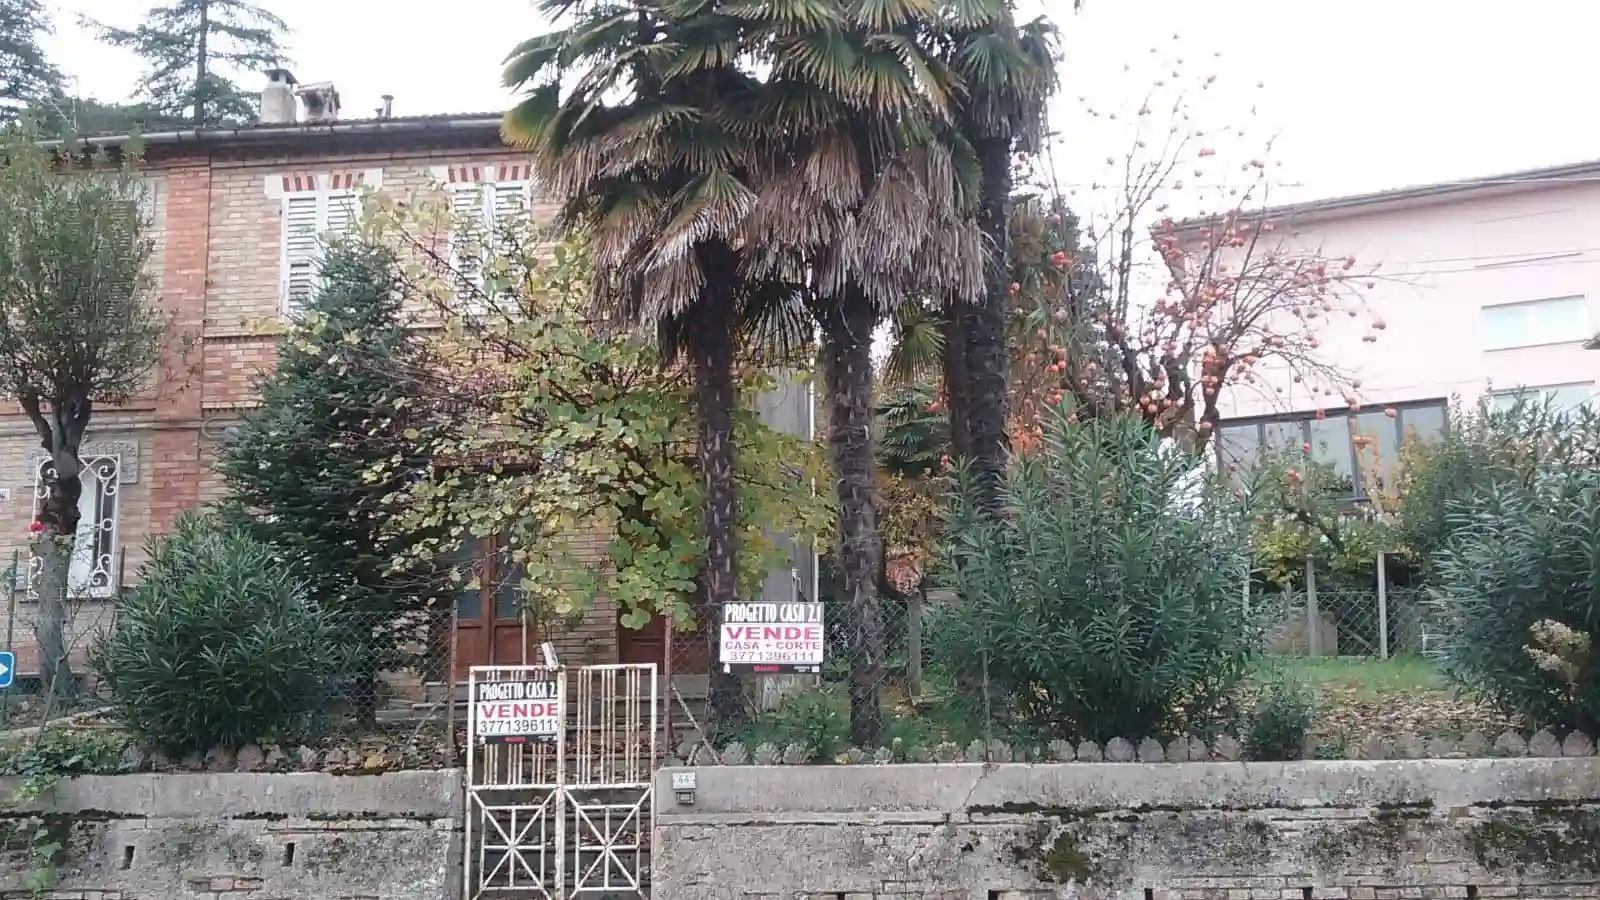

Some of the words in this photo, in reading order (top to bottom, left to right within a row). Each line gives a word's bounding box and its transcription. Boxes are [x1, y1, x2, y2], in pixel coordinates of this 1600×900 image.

[725, 603, 777, 622] PROGETTO
[780, 603, 805, 622] CASA
[726, 627, 820, 640] VENDE
[725, 641, 760, 650] CASA
[776, 641, 821, 650] CORTE
[730, 651, 815, 661] 3771396111
[480, 682, 524, 700] PROGETTO
[526, 681, 548, 699] CASA
[482, 703, 558, 718] VENDE
